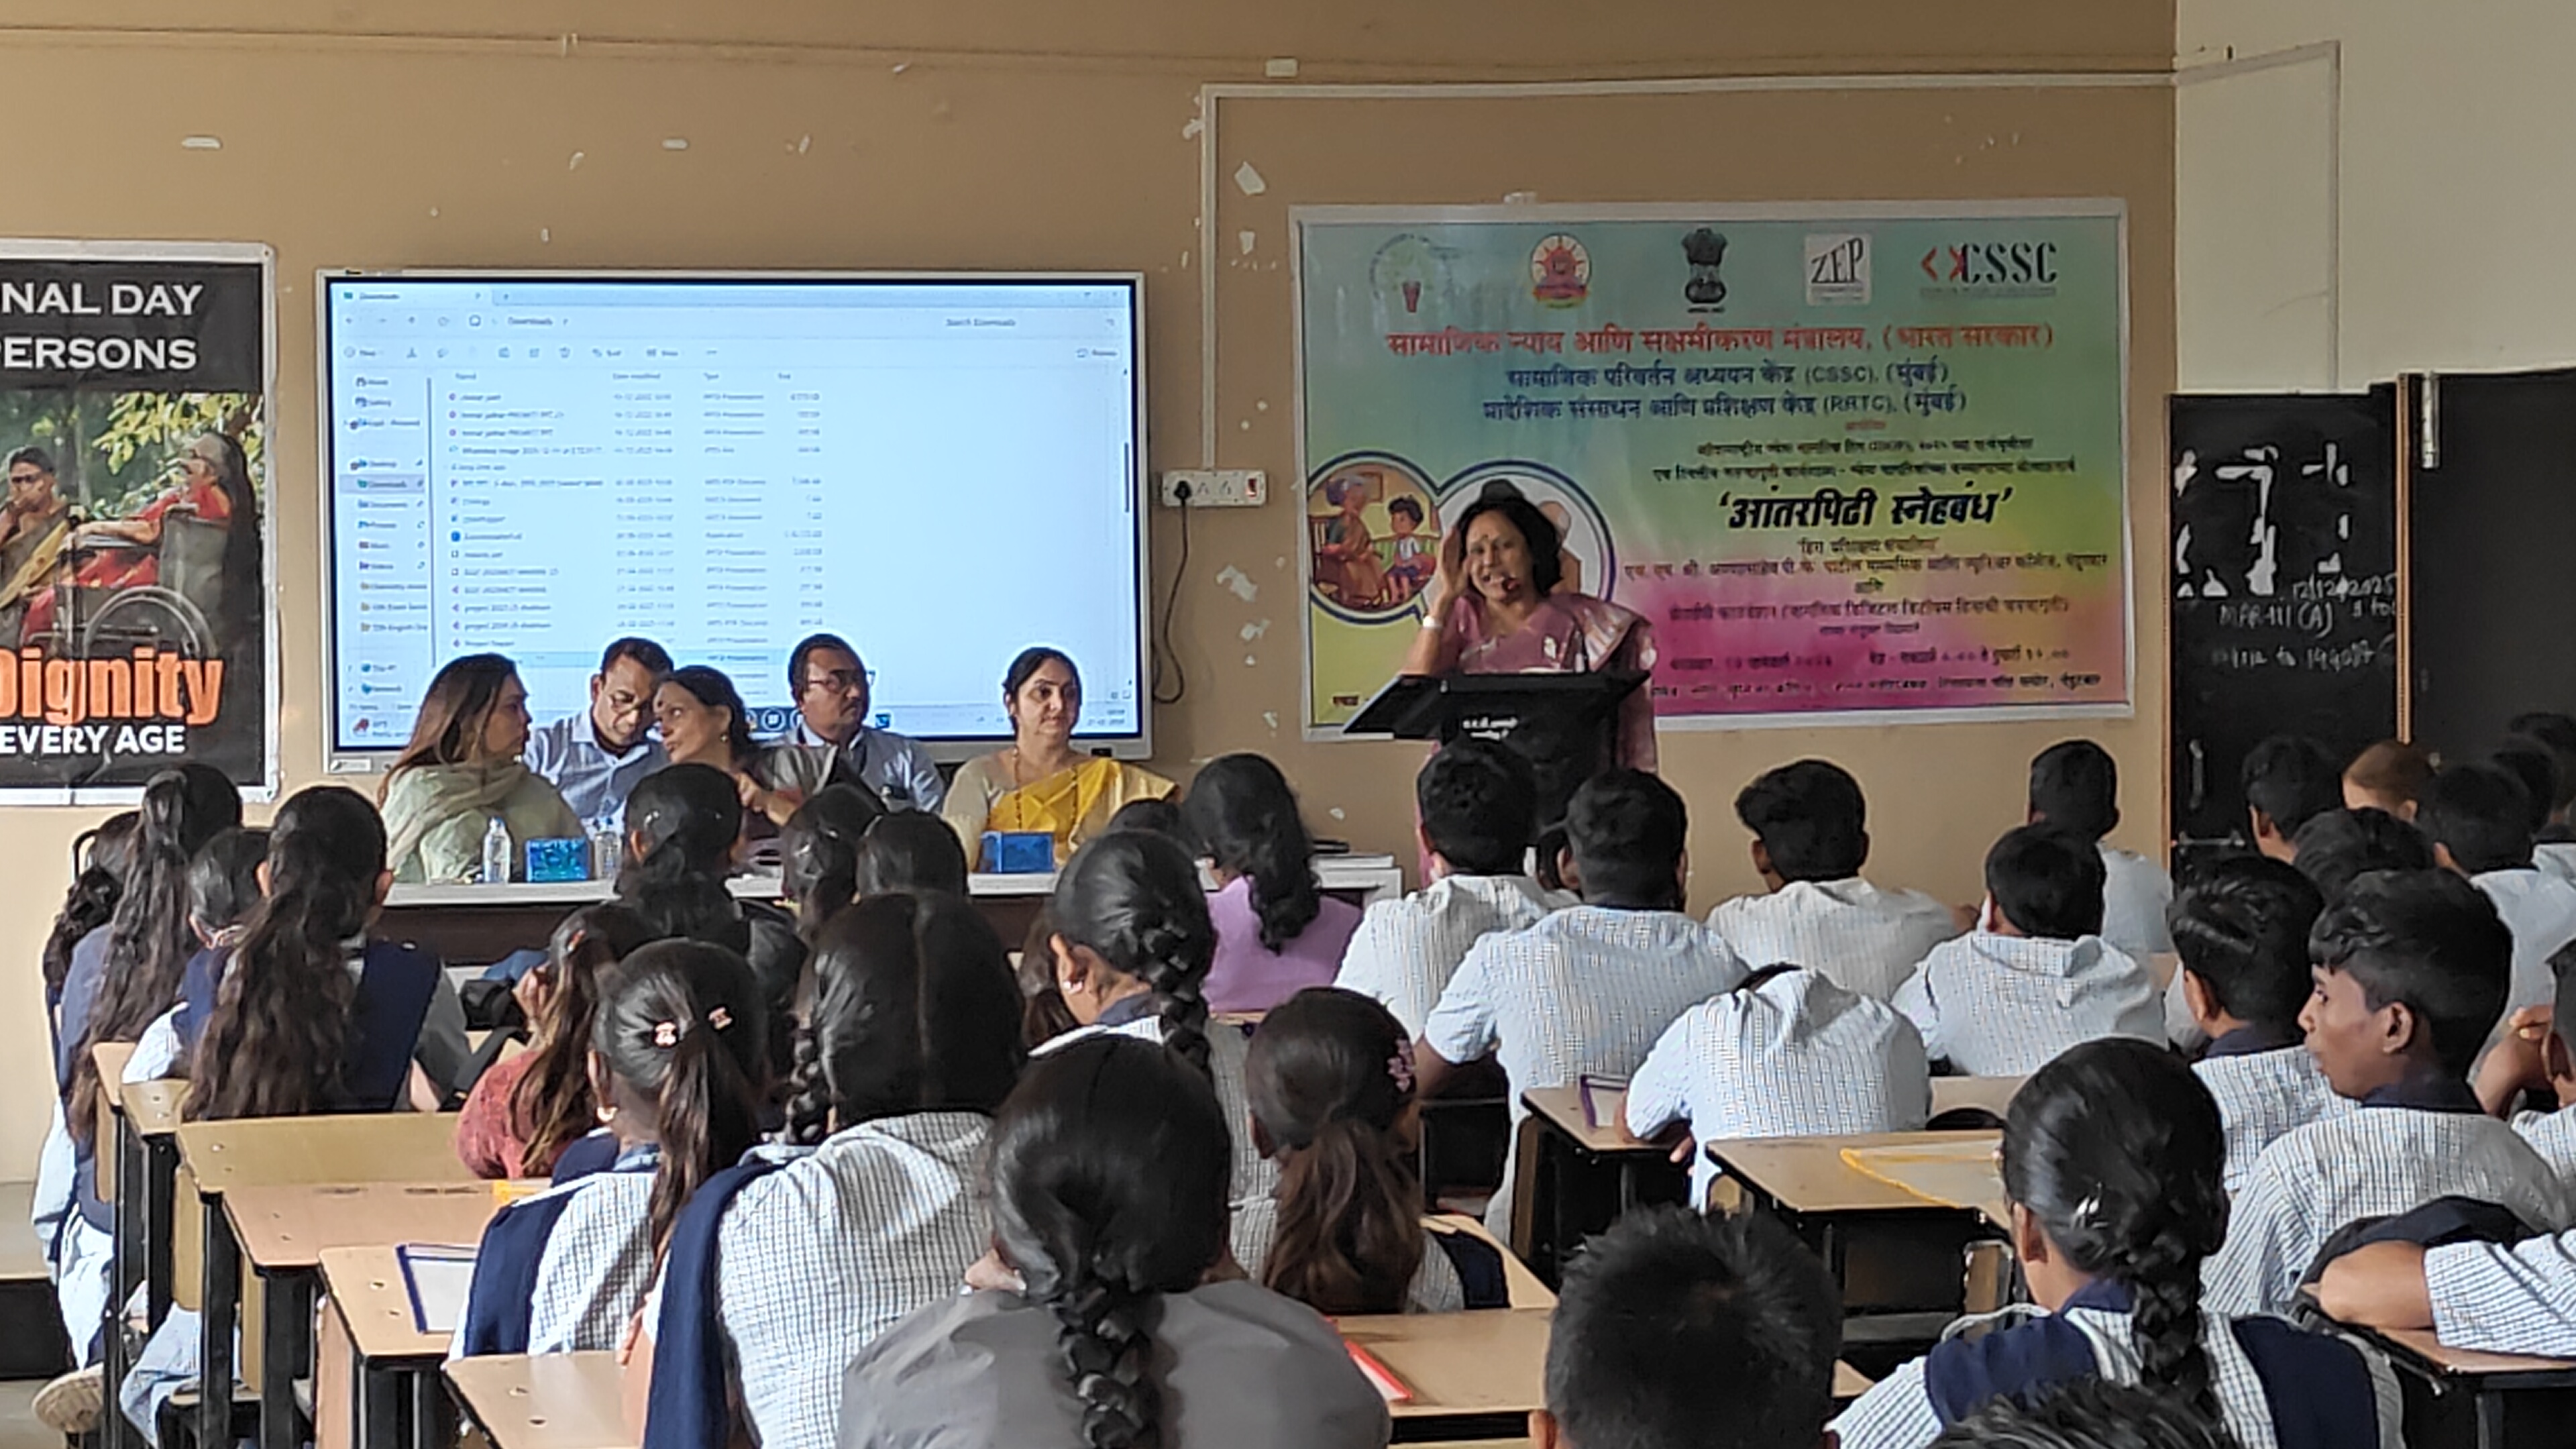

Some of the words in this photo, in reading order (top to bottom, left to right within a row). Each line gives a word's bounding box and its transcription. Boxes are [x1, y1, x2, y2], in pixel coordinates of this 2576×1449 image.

[1811, 236, 1864, 284] ZEP
[1960, 242, 2057, 284] CSSC
[2, 282, 101, 314] NAL
[111, 284, 203, 315] DAY
[0, 337, 197, 369] ERSONS
[1385, 323, 1501, 356] सामाजिक
[1507, 329, 1565, 354] न्याय
[1574, 322, 1633, 354] आणि
[1640, 322, 1774, 353] सक्षमीकरण
[1507, 362, 1598, 387] सामाजिक
[1605, 359, 1675, 385] परिवर्तन
[1684, 366, 1755, 384] अध्ययन
[1483, 394, 1562, 421] प्रादेशिक
[1570, 394, 1641, 419] संसाधन
[1649, 392, 1697, 417] आणि
[1703, 390, 1776, 418] प्रशिक्षण
[0, 725, 109, 755] EVERY
[114, 725, 186, 755] AGE
